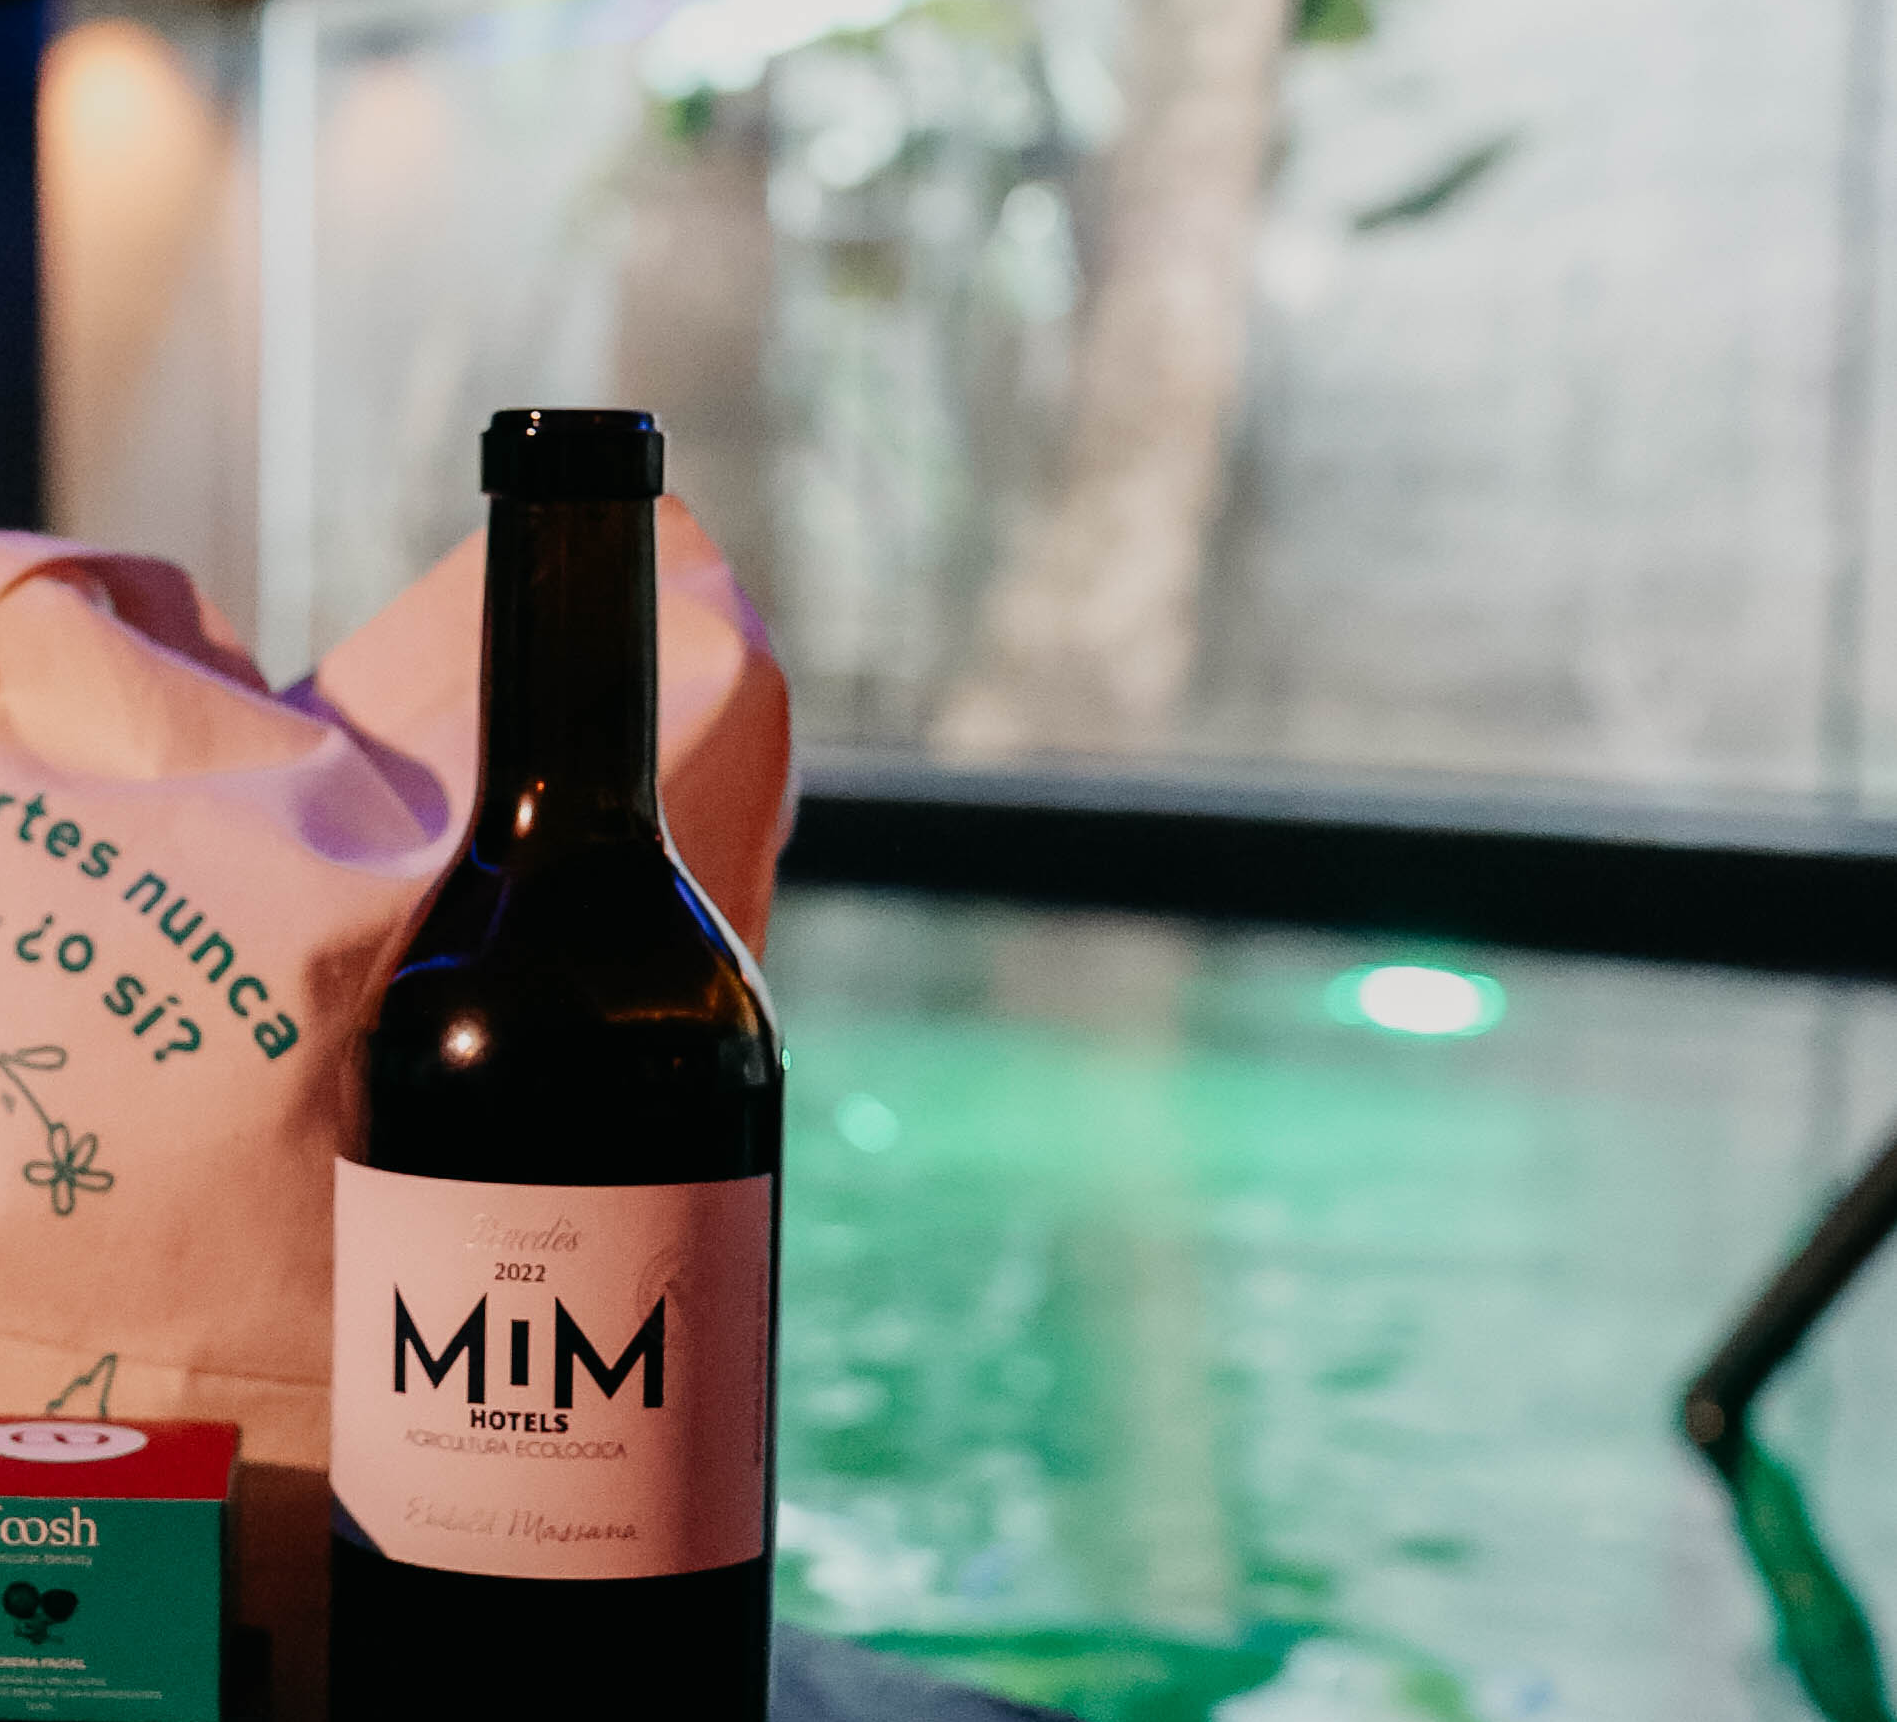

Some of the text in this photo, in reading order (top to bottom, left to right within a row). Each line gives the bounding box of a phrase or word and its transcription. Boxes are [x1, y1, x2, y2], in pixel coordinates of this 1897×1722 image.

[16, 913, 94, 973] ¿o
[103, 973, 203, 1063] sí?
[123, 871, 300, 1060] nunca
[494, 1262, 547, 1282] 2022
[470, 1409, 570, 1433] HOTELS
